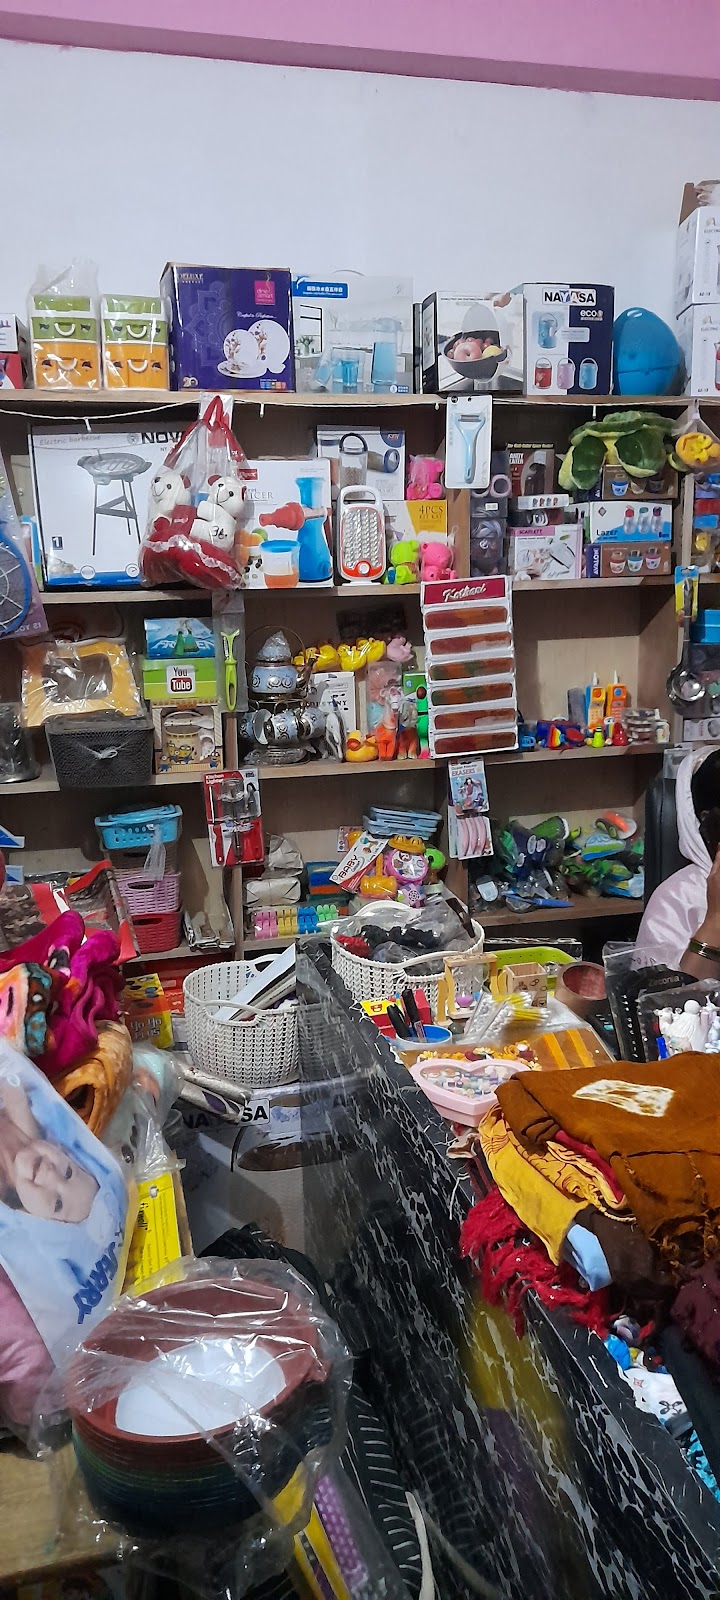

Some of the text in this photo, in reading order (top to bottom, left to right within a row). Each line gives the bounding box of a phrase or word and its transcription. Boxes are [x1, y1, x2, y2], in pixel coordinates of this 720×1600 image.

[544, 291, 595, 303] NAYASA
[39, 438, 67, 446] Electric
[419, 505, 443, 514] 4PCS
[172, 666, 188, 677] You
[171, 679, 191, 690] Tube
[451, 768, 476, 776] ERASERS
[338, 855, 358, 879] BABY
[182, 1105, 269, 1130] NASA
